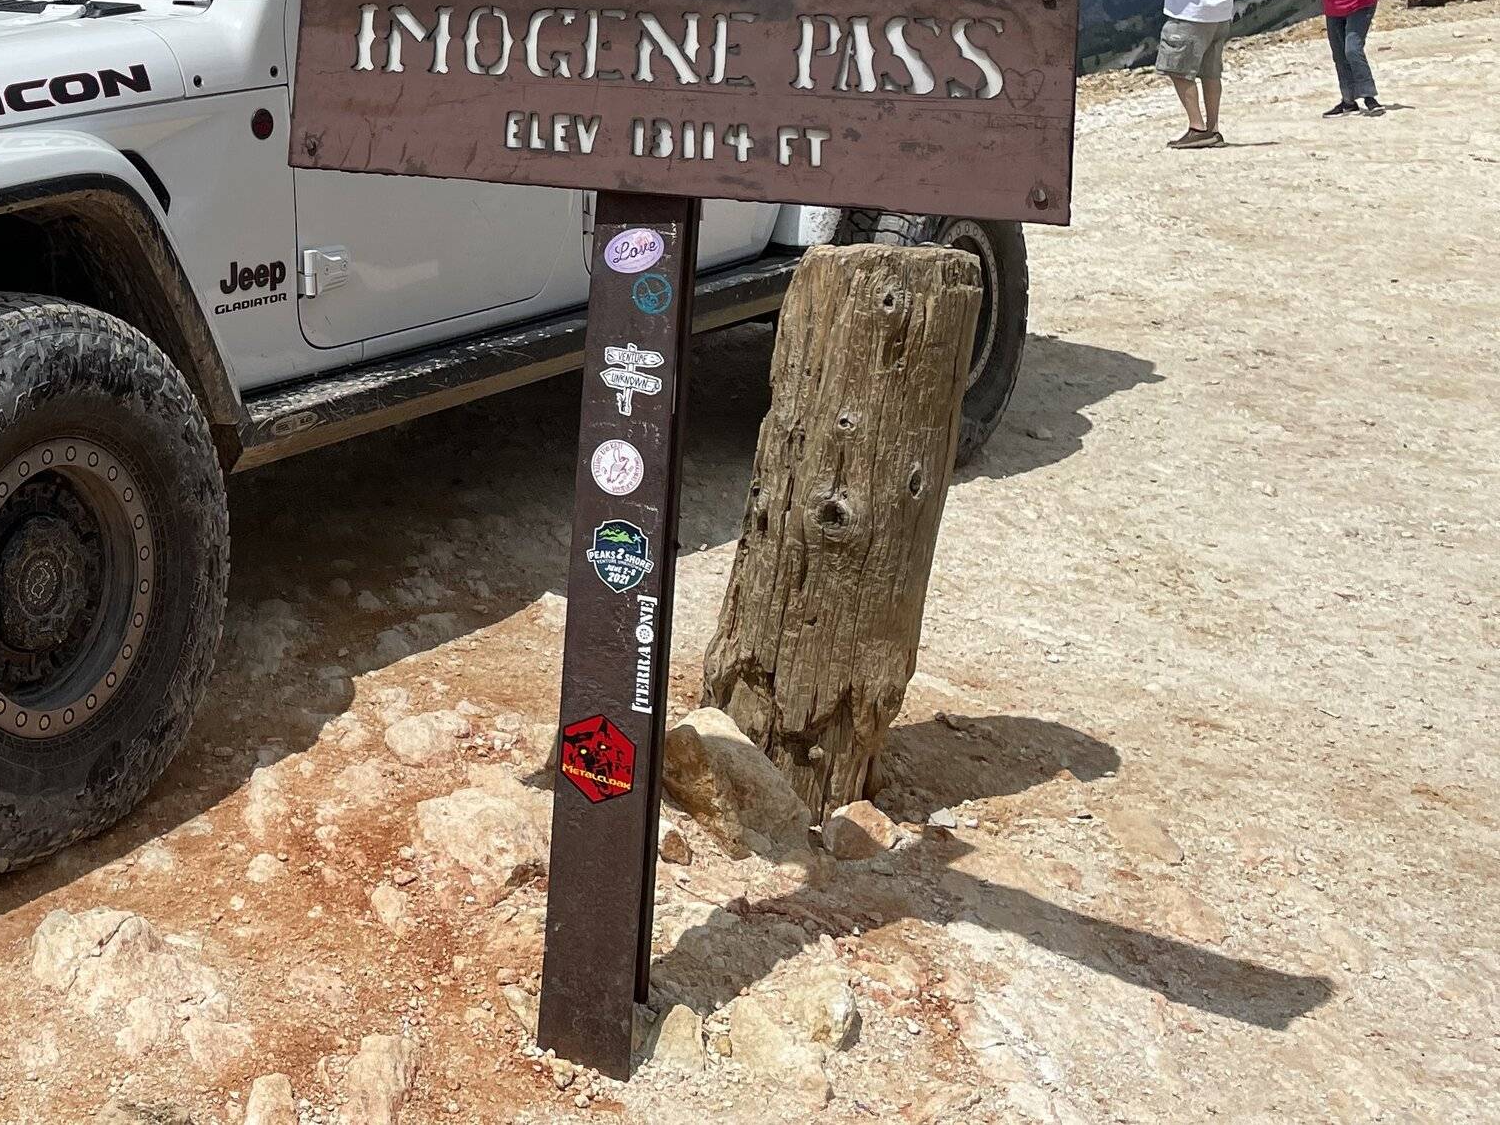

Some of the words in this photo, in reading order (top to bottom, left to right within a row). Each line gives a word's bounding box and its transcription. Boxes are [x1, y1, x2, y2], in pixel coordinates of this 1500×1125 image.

[351, 3, 759, 85] IMOGENE
[789, 14, 1004, 99] PASS
[505, 111, 601, 155] ELEV
[631, 117, 754, 162] 13114
[778, 127, 830, 167] FT
[612, 241, 658, 264] Love
[220, 261, 286, 295] Jeep
[215, 293, 287, 315] GLADIATOR
[588, 550, 616, 560] PEAKS
[617, 548, 625, 560] 2
[624, 553, 652, 571] SHORE
[604, 564, 622, 574] JUNE
[607, 572, 630, 585] 2021
